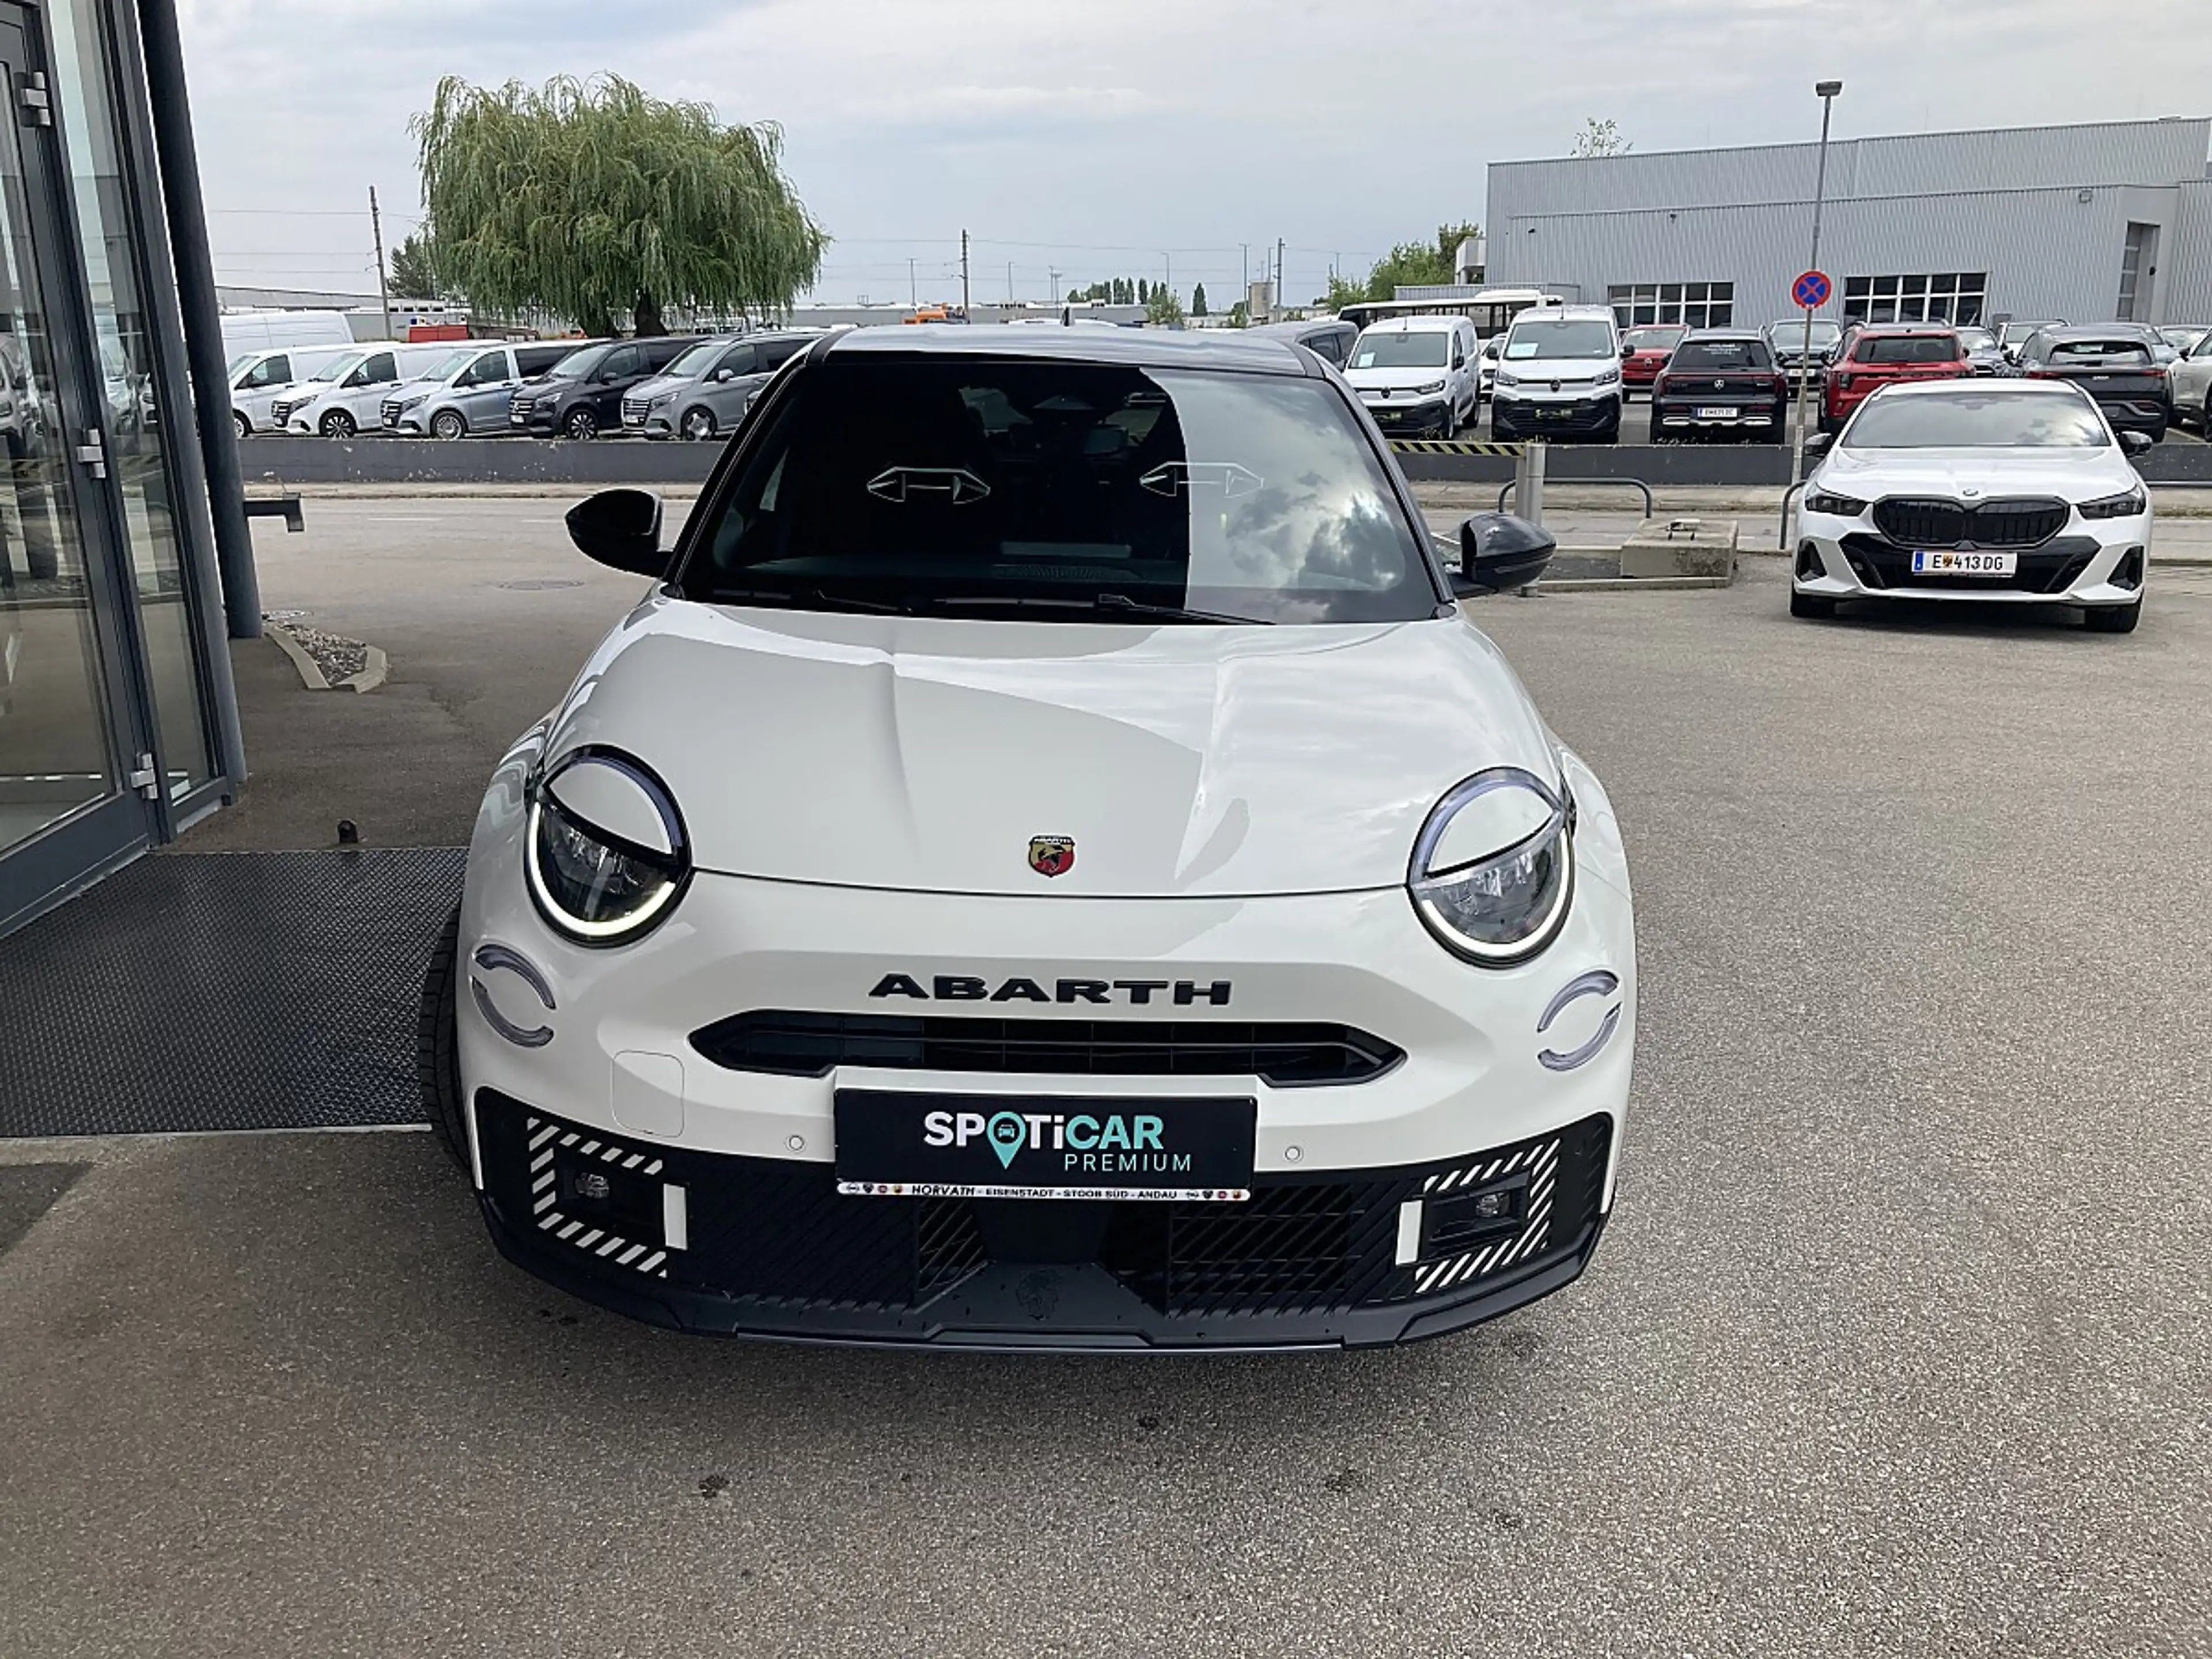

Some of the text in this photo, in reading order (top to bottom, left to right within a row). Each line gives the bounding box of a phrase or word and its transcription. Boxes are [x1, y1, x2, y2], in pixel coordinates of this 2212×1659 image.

[1933, 555, 1942, 569] E
[1954, 555, 1980, 570] 413
[868, 973, 1230, 1005] ABARTH
[1065, 1154, 1191, 1172] PREMIUM
[912, 1185, 975, 1196] HORVATH
[986, 1188, 1055, 1198] EISENSTADT
[1138, 1190, 1177, 1199] ANDAU
